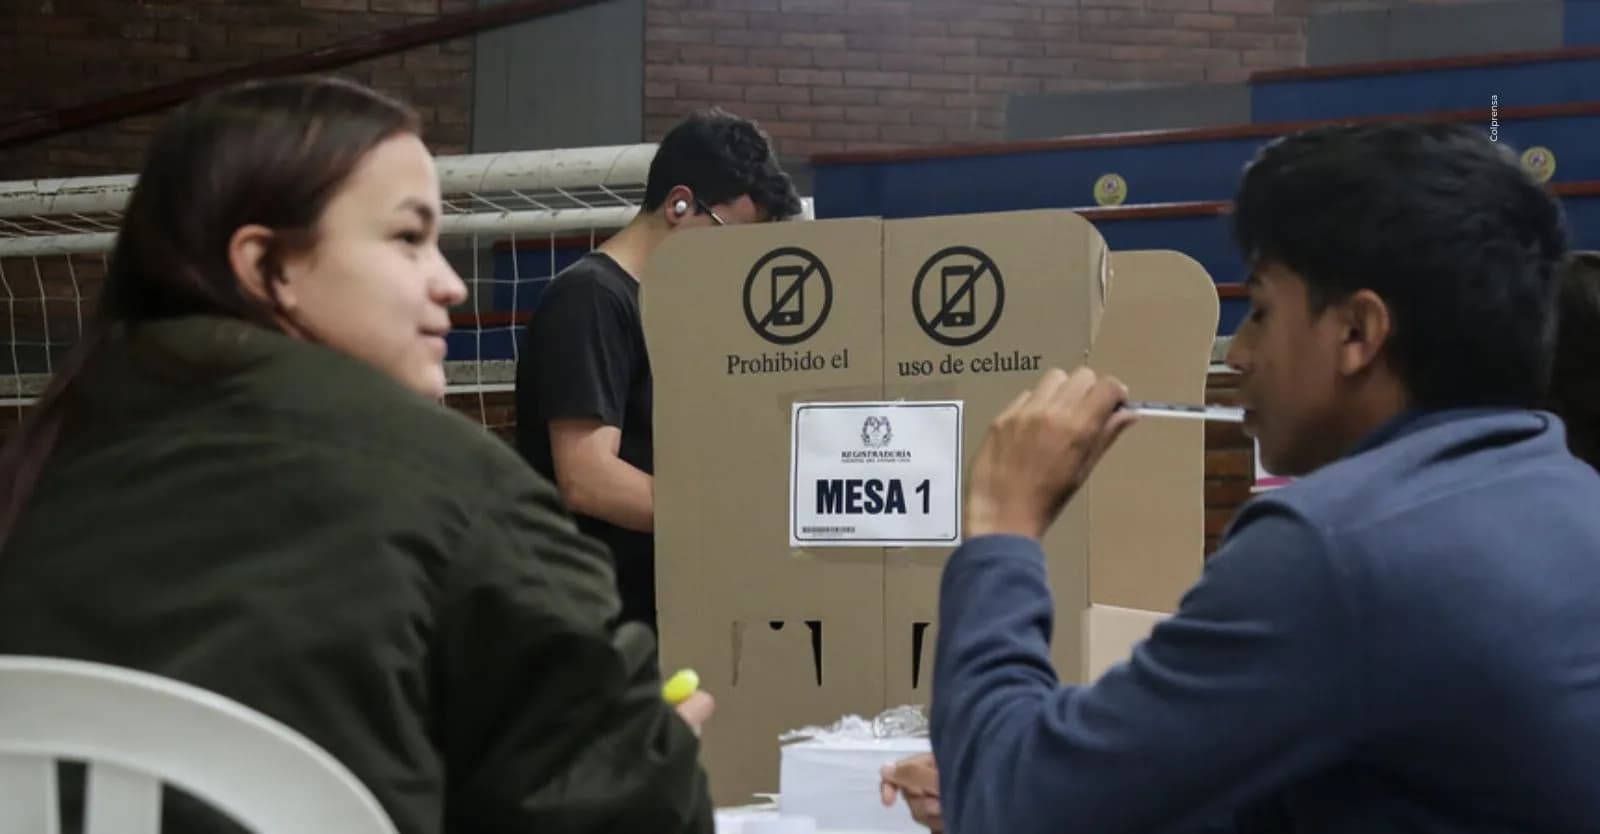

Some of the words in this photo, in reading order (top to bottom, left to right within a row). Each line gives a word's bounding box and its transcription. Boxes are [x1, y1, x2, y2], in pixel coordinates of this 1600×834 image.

[727, 351, 826, 375] Prohibido
[830, 348, 849, 369] el
[898, 360, 934, 377] uso
[939, 353, 964, 375] de
[970, 350, 1042, 373] celular
[816, 479, 907, 514] MESA
[915, 479, 931, 514] 1
